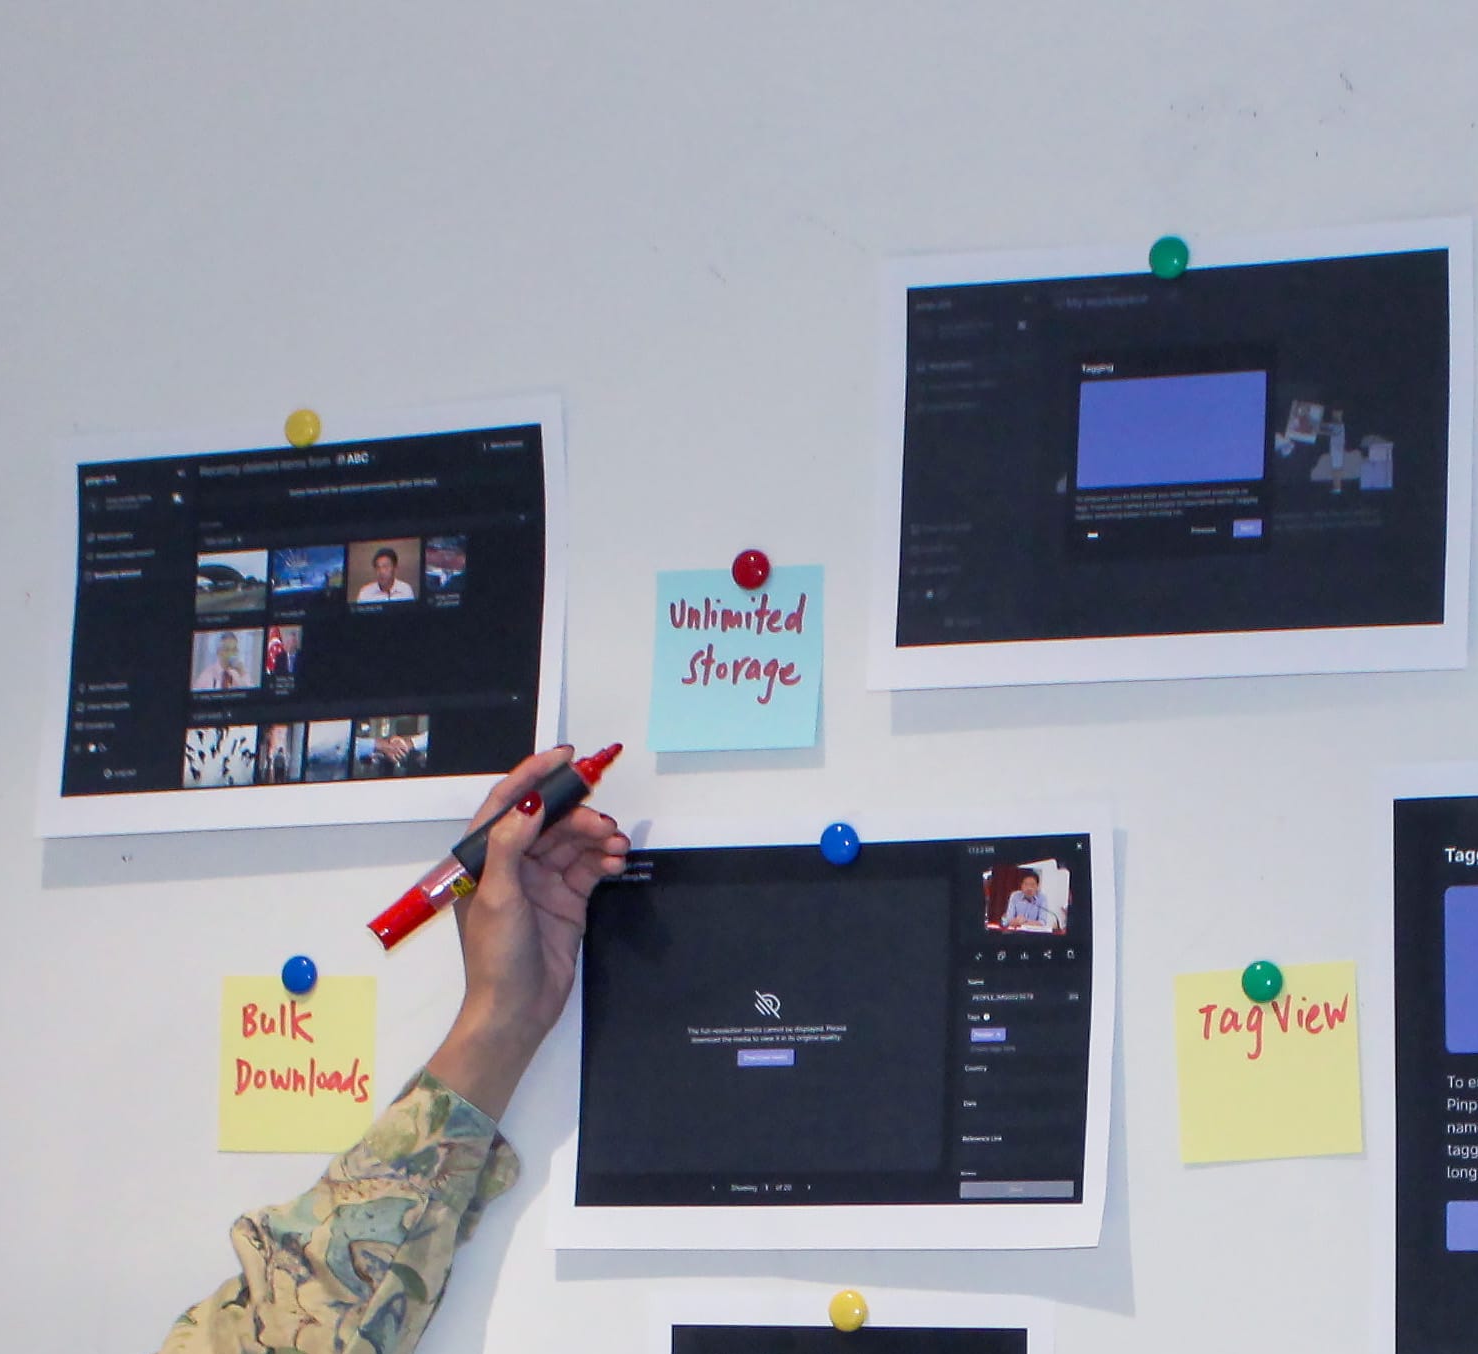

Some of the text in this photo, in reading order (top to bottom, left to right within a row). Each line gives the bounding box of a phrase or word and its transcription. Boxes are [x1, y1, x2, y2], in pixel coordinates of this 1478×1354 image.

[670, 593, 807, 635] Unlimited
[681, 643, 802, 705] Storage
[242, 1000, 314, 1043] Bulk
[234, 1057, 370, 1103] Downloads
[1447, 1075, 1463, 1088] To
[1447, 1166, 1477, 1181] long
